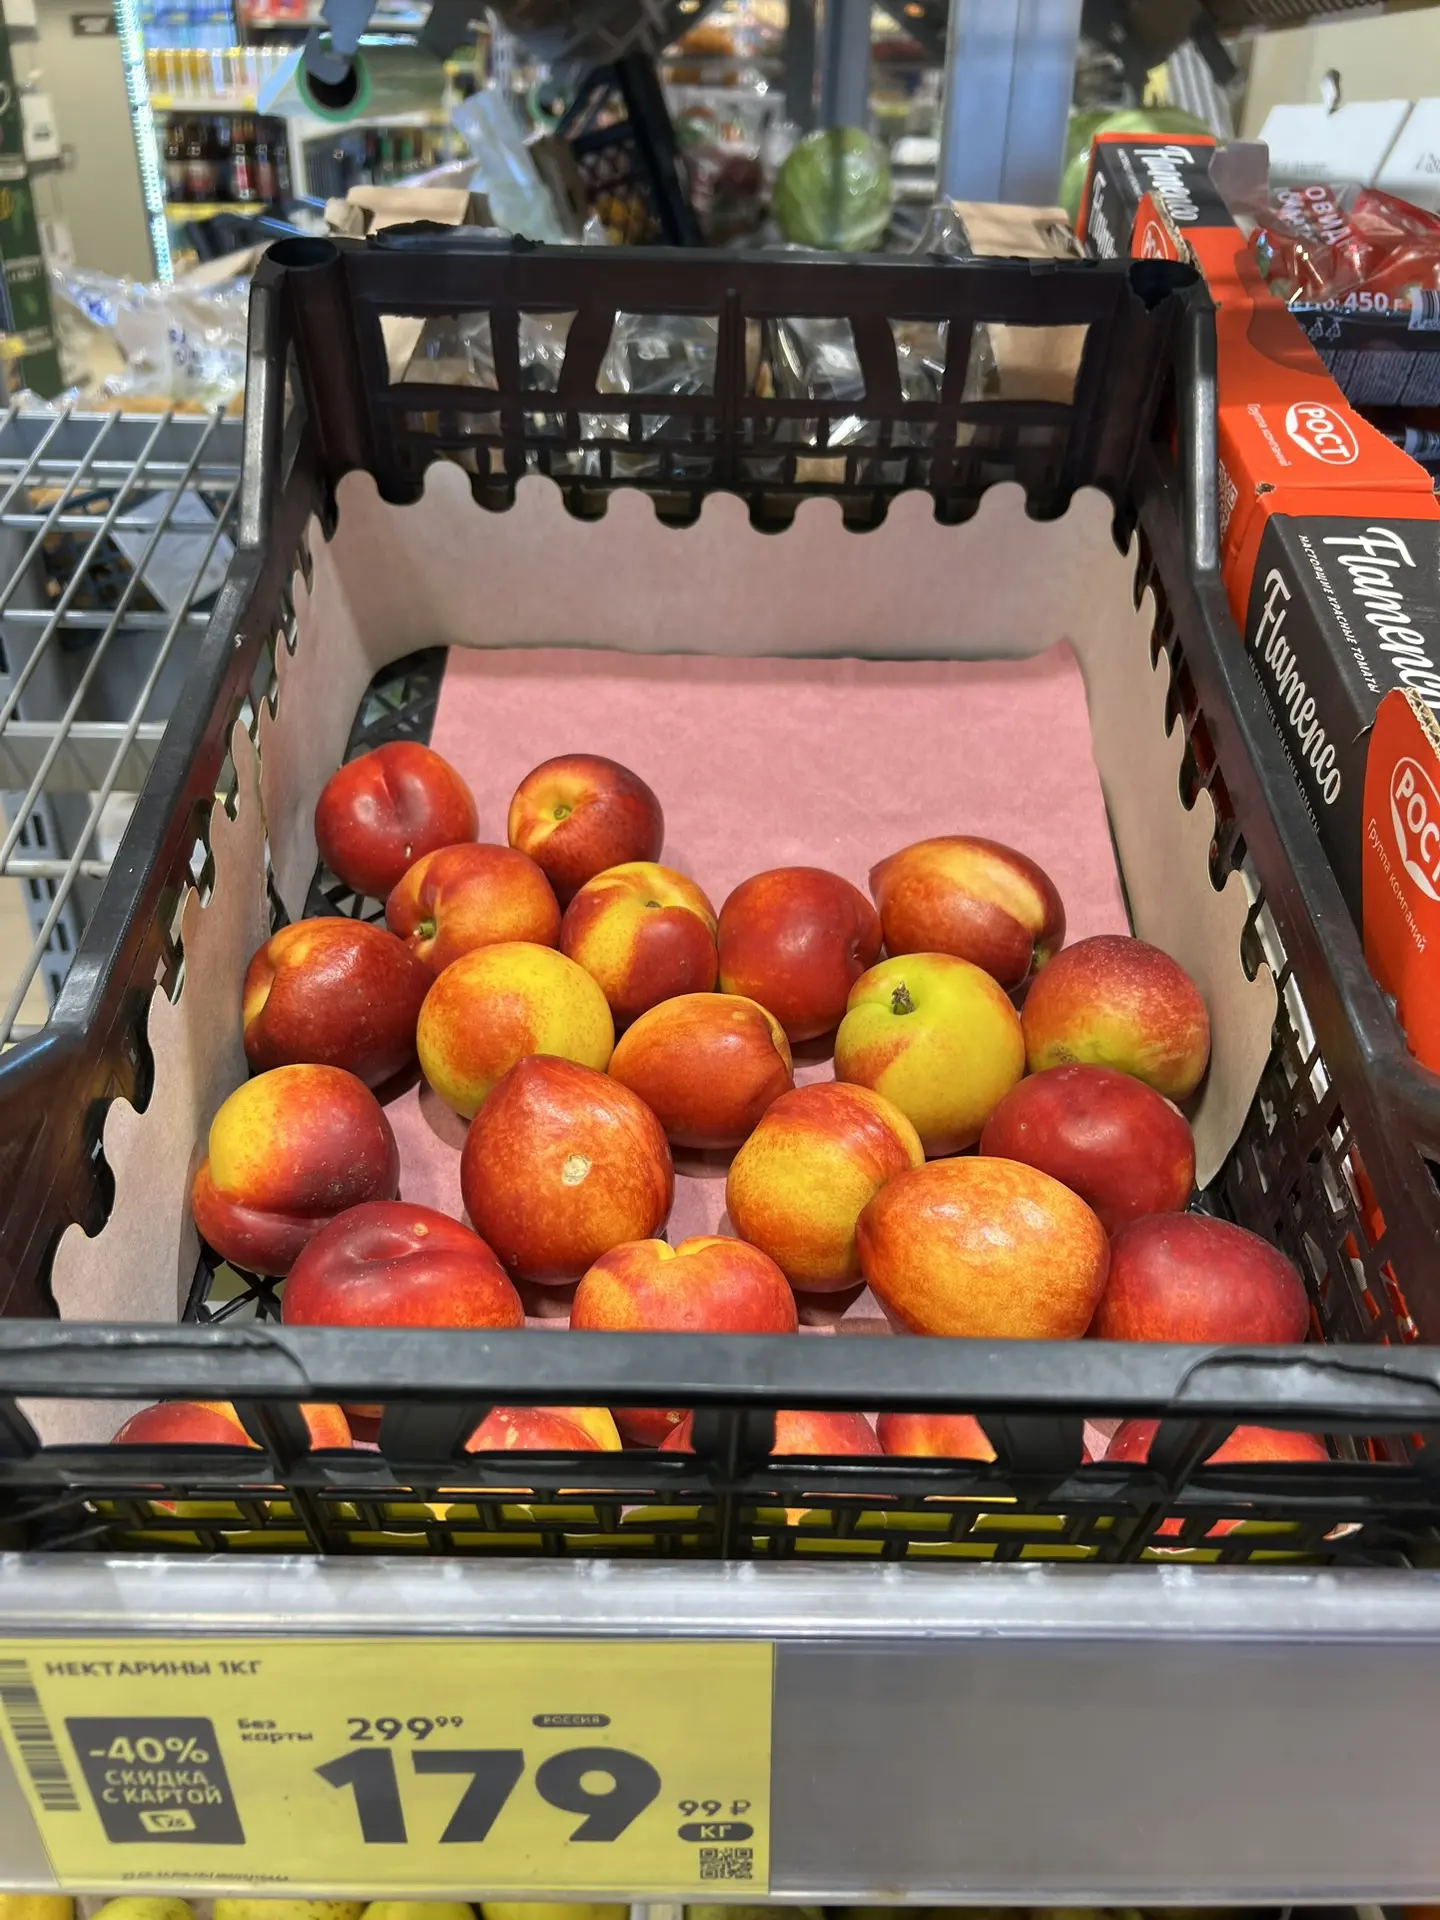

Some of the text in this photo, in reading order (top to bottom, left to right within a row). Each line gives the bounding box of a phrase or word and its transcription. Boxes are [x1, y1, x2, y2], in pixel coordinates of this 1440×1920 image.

[1345, 292, 1389, 313] 450
[1297, 407, 1351, 459] РОСТ
[1298, 534, 1381, 694] НАСТОЯЩИЕ КРАСНЫЕ ТОМАТЫ
[1322, 526, 1440, 709] Flamenc
[1254, 567, 1342, 805] Flamenco
[1367, 817, 1429, 953] Группа компаний
[45, 1660, 262, 1677] НЕКТАРИНЫ 1КГ
[237, 1717, 277, 1730] Без
[542, 1715, 601, 1726] РОССИЯ
[240, 1731, 314, 1744] карты
[88, 1736, 210, 1765] -40%
[104, 1769, 209, 1787] СКИДКА
[102, 1785, 223, 1804] С КАРТОЙ
[312, 1745, 662, 1844] 179
[677, 1799, 722, 1817] 99
[700, 1824, 731, 1839] КГ
